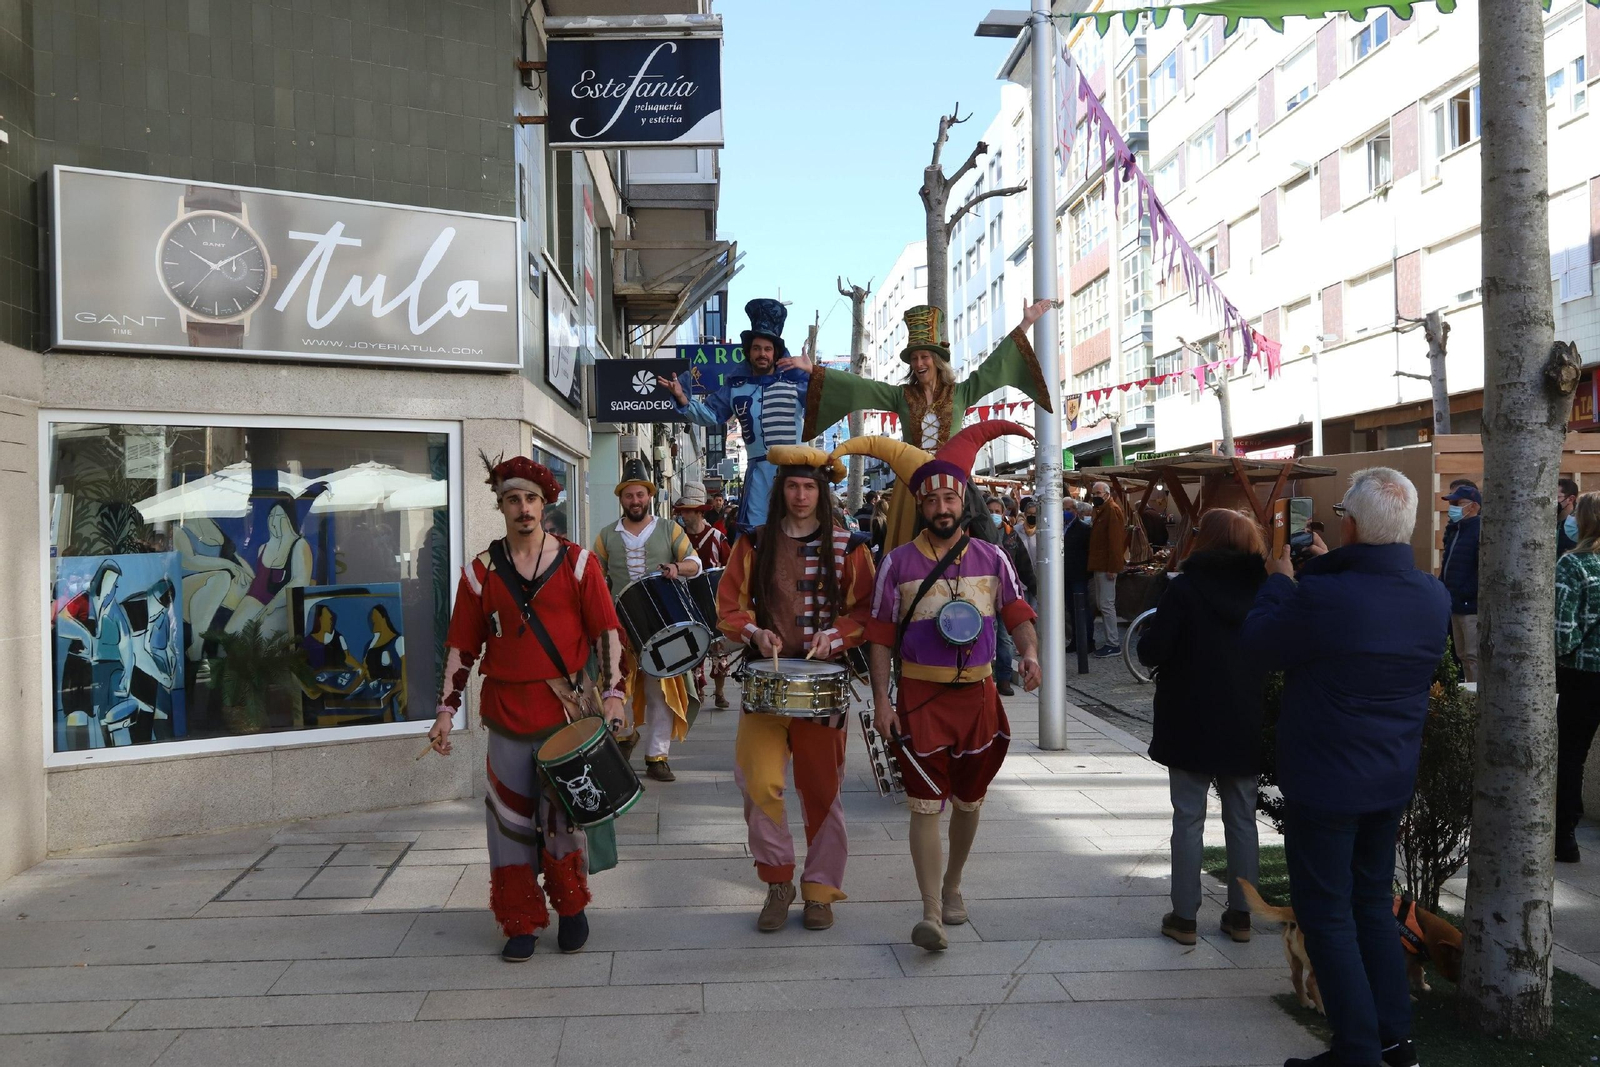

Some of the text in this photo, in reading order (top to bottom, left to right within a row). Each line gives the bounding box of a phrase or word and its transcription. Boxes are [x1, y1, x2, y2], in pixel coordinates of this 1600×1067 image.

[570, 41, 699, 139] Estefanía
[634, 101, 683, 113] peluquería
[641, 114, 683, 126] y estética
[273, 220, 508, 336] tula
[74, 311, 166, 328] GANT
[112, 328, 133, 336] TIME
[301, 338, 484, 355] WWW.JOYERIATULA.COM
